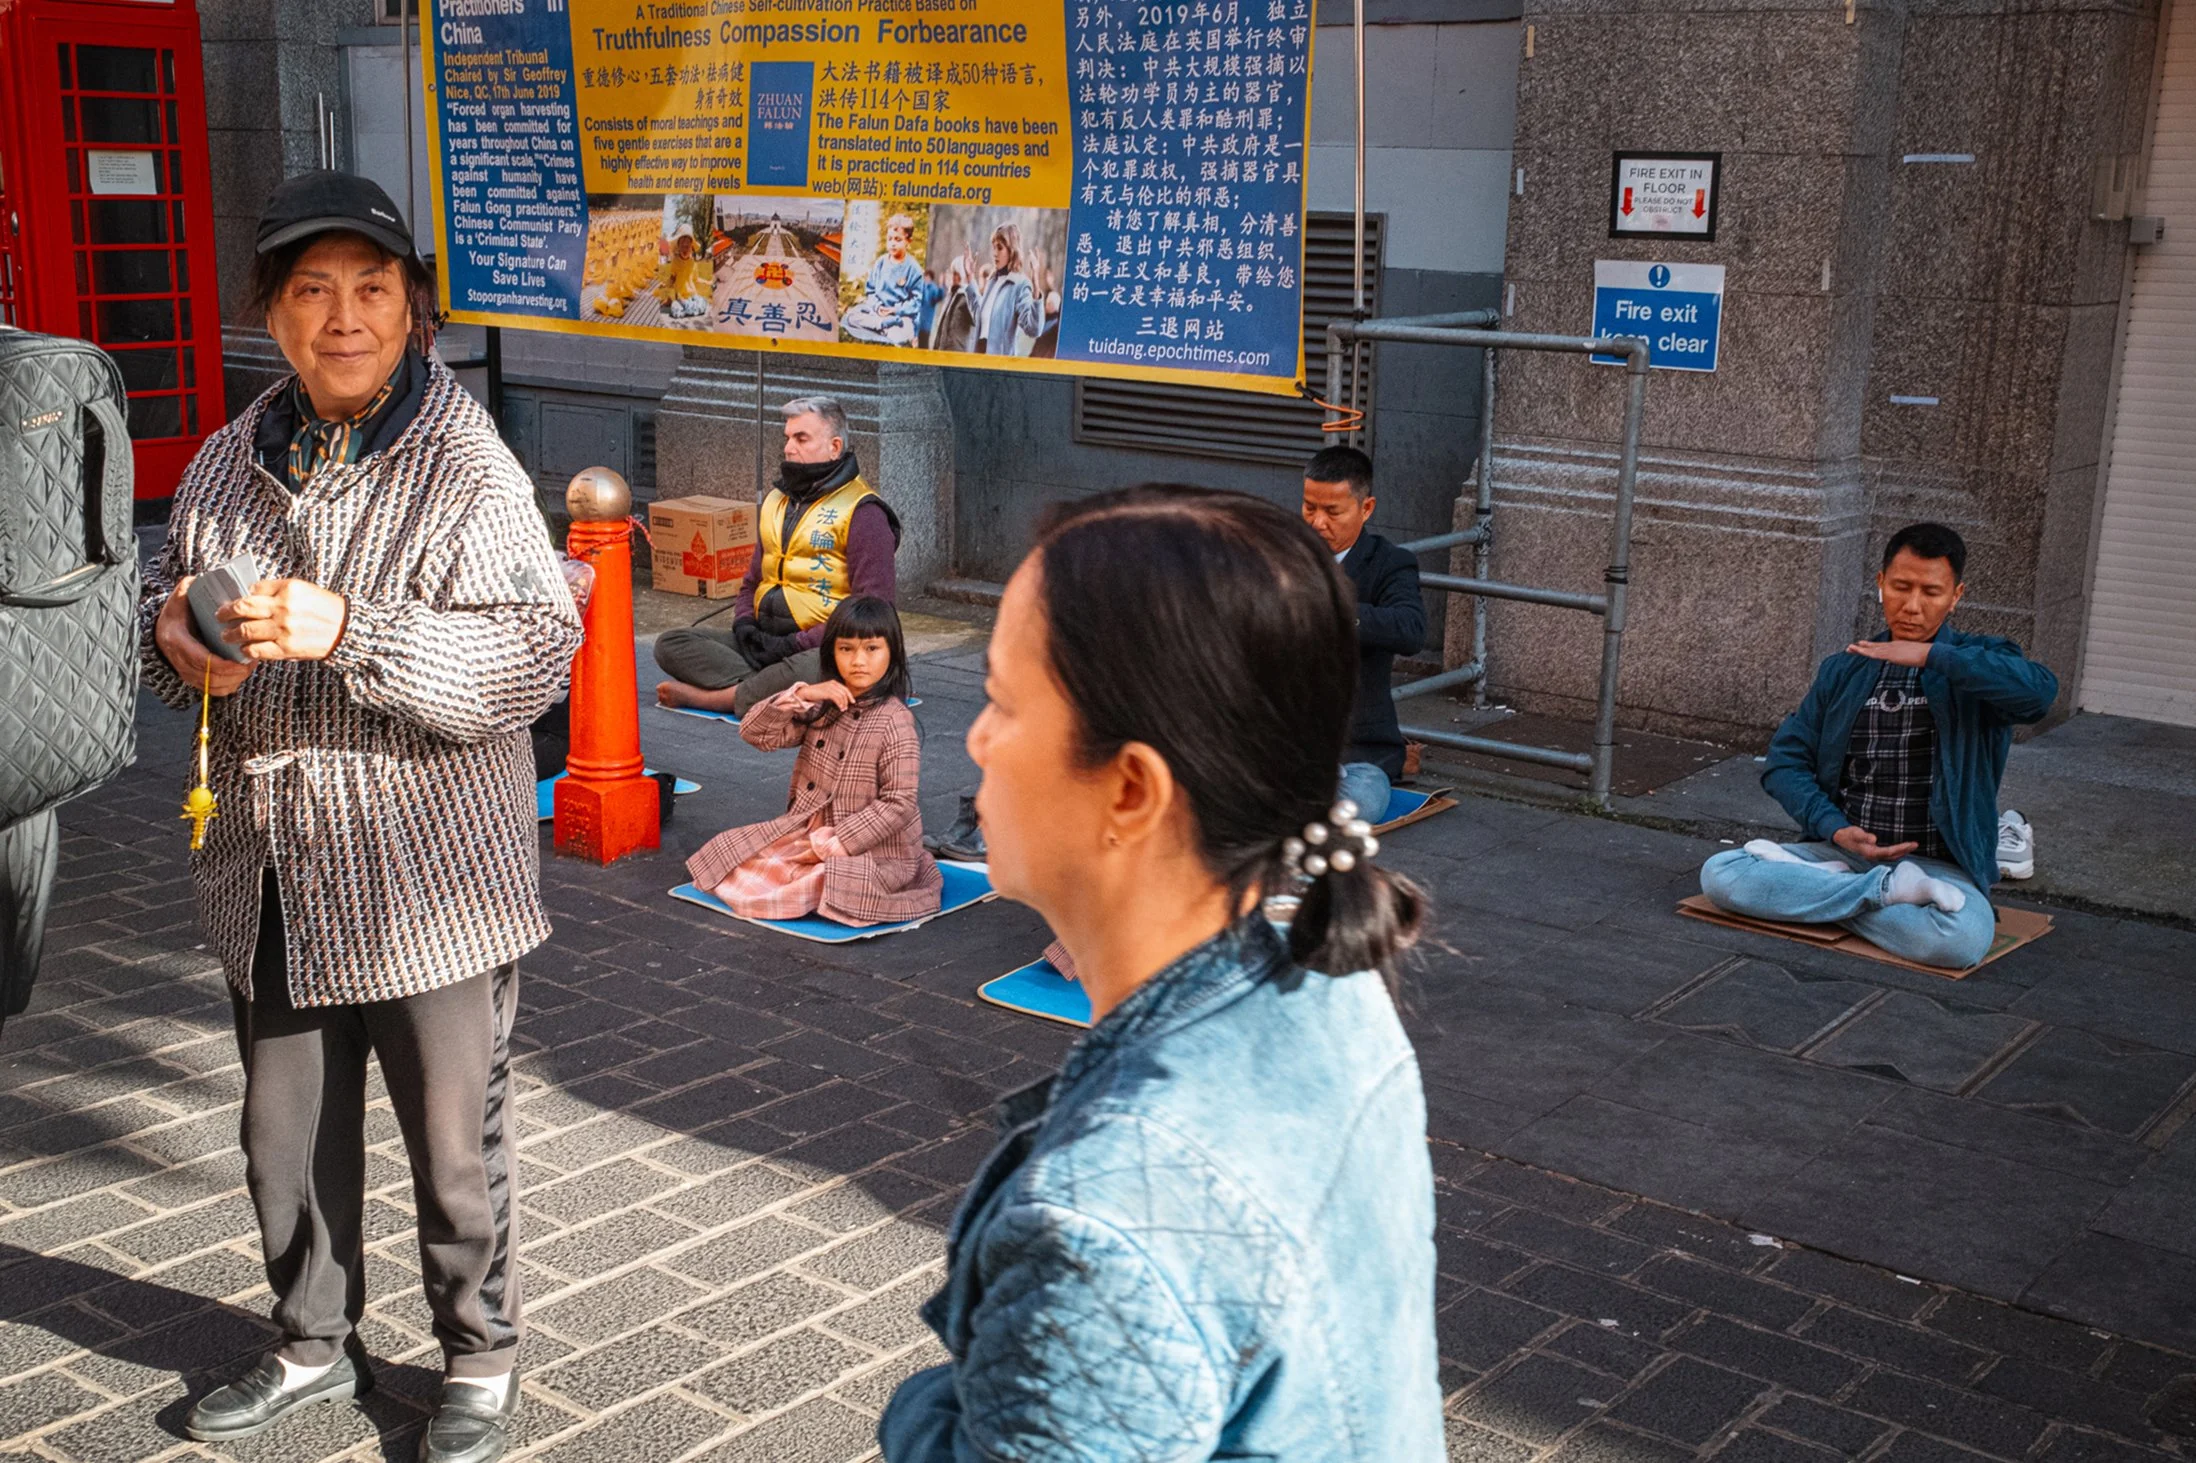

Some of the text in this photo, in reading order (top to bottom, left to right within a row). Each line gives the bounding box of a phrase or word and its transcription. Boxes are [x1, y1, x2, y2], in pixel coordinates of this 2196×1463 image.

[439, 0, 525, 17] Practitioners
[635, 5, 645, 20] A
[648, 1, 708, 20] Traditional
[710, 0, 744, 16] Chinese
[858, 0, 912, 12] Practice
[916, 0, 956, 11] Based
[960, 0, 977, 10] on
[441, 22, 483, 45] China
[592, 18, 1027, 50] Truthfulness Compassion Forbearance
[1075, 25, 1307, 54] 人民法庭在英国举行终审
[443, 48, 548, 68] Independent Tribunal
[445, 66, 566, 84] Chaired by Sir Geoffrey
[446, 84, 560, 100] Nice, QC, 17th June 2019
[695, 87, 743, 110] 身有奇效
[757, 93, 803, 106] ZHUAN
[819, 87, 951, 112] 洪传114个国家
[492, 104, 515, 119] organ
[520, 102, 570, 119] harvesting
[757, 107, 802, 119] FALUN
[448, 119, 572, 133] has been committed for
[584, 113, 743, 132] Consists of moral teachings and
[817, 112, 1058, 135] The Falun Dafa books have been
[449, 136, 574, 153] years throughout China on
[594, 136, 742, 154] five gentle exercises that are a
[818, 134, 1049, 159] translated into 50 languages and
[450, 155, 457, 165] a
[459, 153, 510, 169] significant
[600, 154, 741, 173] highly effective way to improve
[817, 155, 1031, 178] it is practiced in 114 countries
[451, 168, 577, 186] against humanity have
[1629, 168, 1702, 179] FIRE EXIT IN
[628, 175, 740, 192] health and energy levels
[893, 180, 992, 204] falundafa.org
[1643, 182, 1686, 193] FLOOR
[452, 184, 580, 203] been committed against
[453, 199, 481, 213] Falun
[485, 201, 512, 217] Gong
[454, 216, 582, 237] Chinese Communist Party
[455, 231, 464, 245] is
[466, 235, 473, 245] a
[469, 250, 567, 271] Your Signature Can
[493, 270, 546, 287] Save Lives
[467, 288, 568, 312] Stoporganharvesting.org
[718, 297, 833, 333] 真善忍
[1616, 300, 1697, 323] Fire exit
[1136, 316, 1225, 341] 三退网站
[1088, 338, 1270, 366] tuidang.epochtimes.com
[1658, 332, 1709, 353] clear
